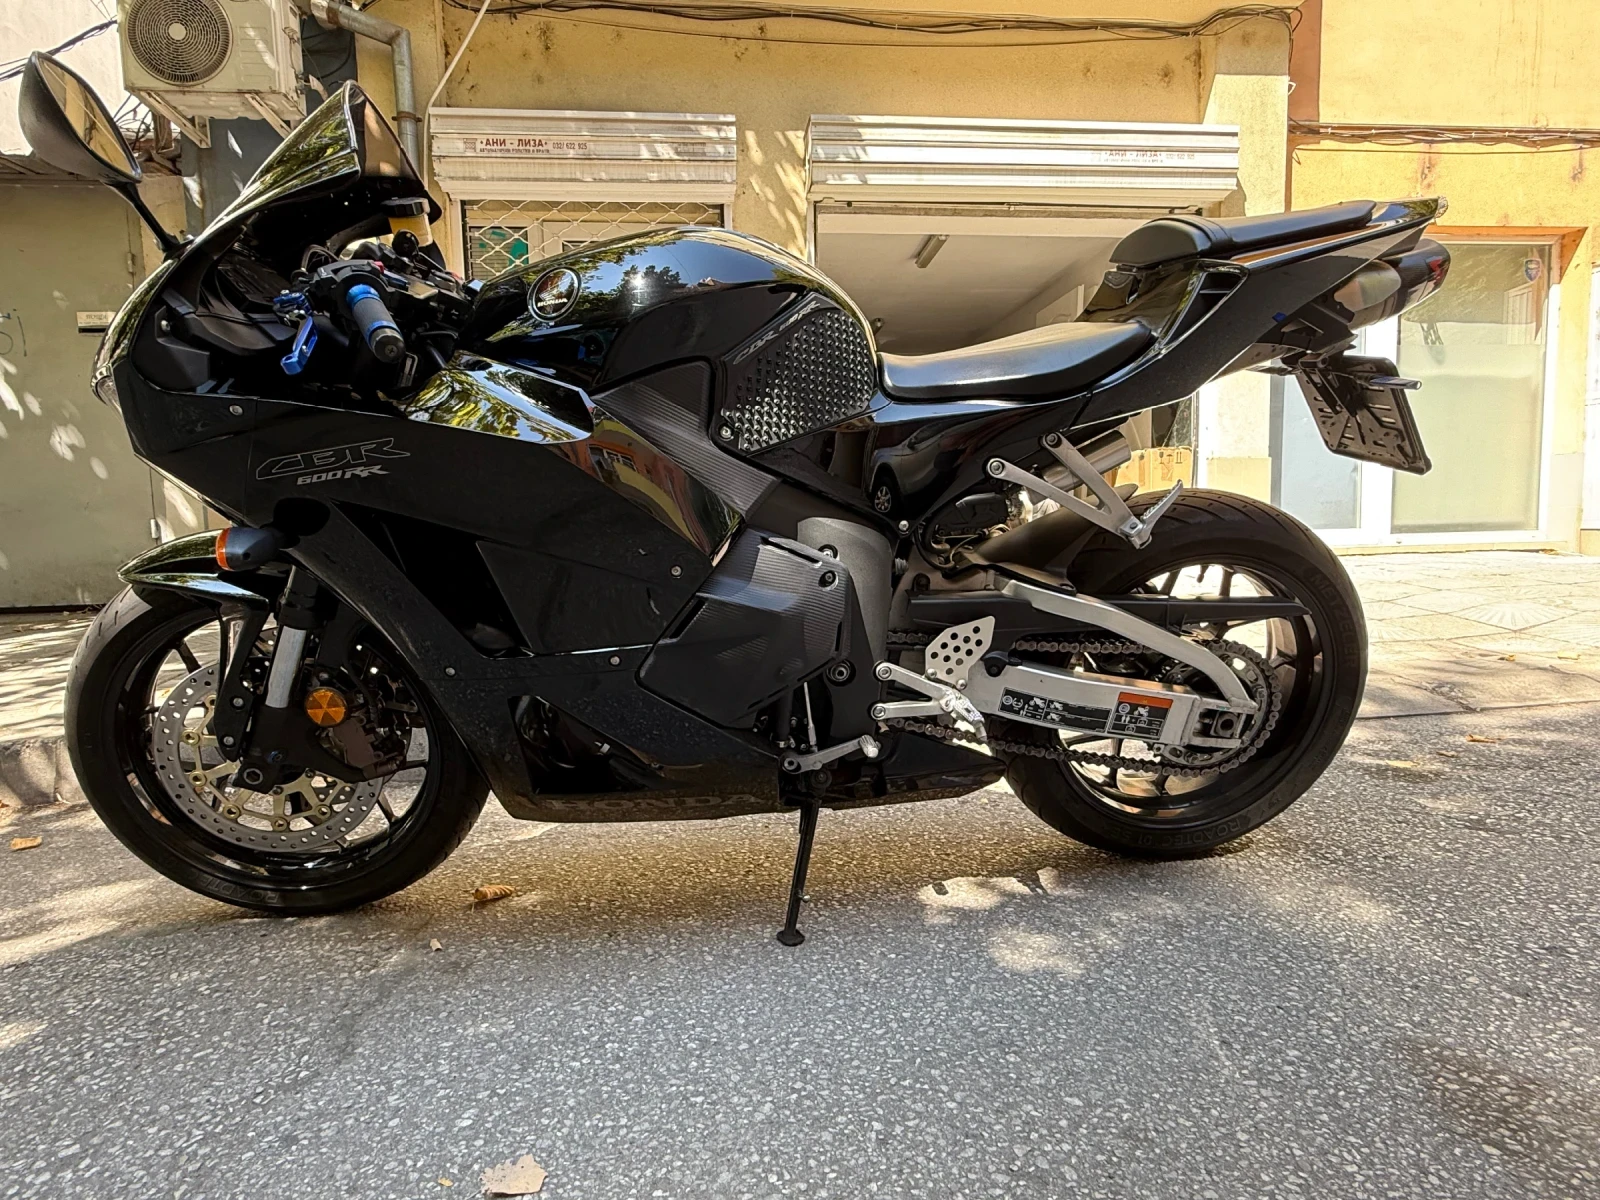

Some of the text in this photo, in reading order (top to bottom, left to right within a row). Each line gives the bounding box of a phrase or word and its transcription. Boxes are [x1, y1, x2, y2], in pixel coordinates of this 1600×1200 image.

[485, 138, 506, 147] АНИ
[517, 138, 545, 148] ЛИЗА
[256, 437, 411, 480] CBR
[296, 464, 391, 486] 600RR
[545, 793, 769, 810] HONDA
[1160, 817, 1242, 847] ROADTEC
